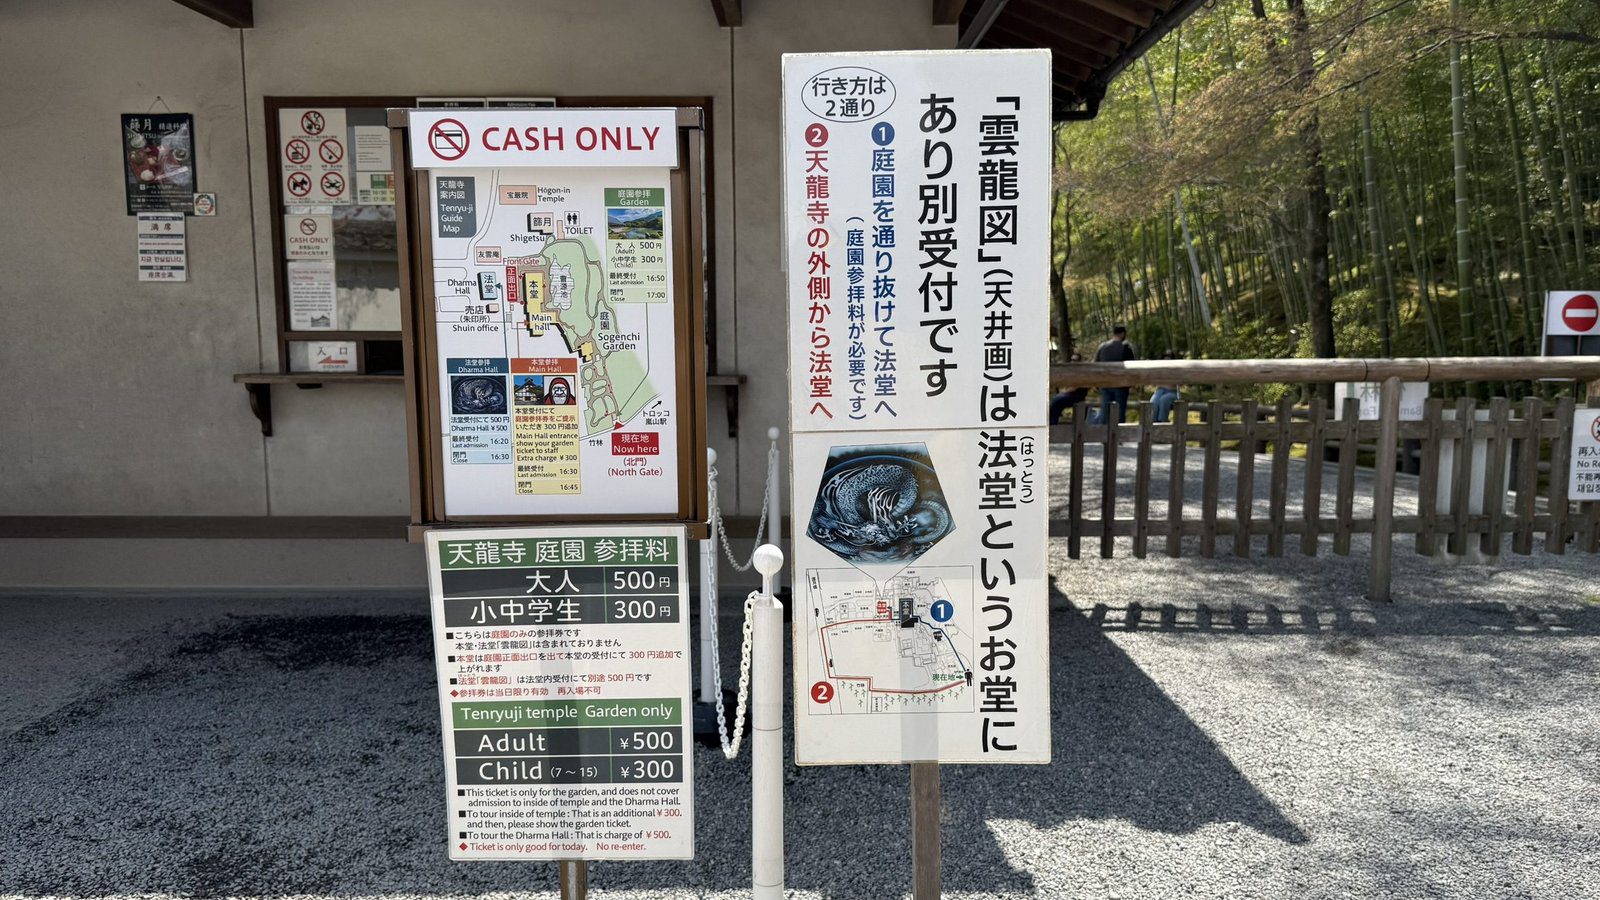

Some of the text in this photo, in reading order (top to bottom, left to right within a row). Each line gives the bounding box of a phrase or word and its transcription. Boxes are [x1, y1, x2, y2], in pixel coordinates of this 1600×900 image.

[812, 76, 886, 97] 行き方は
[825, 98, 876, 117] 2通り
[482, 126, 660, 151] CASH ONLY
[440, 180, 464, 189] 天龍寺
[440, 191, 466, 200] 案内図
[618, 190, 652, 198] 庭園参拝
[440, 204, 474, 214] Tenryu-ji
[443, 225, 460, 233] Map
[564, 226, 594, 234] TOILET
[510, 234, 545, 244] Shigetsu
[918, 93, 958, 398] あり別受付です
[484, 274, 494, 294] 法堂
[507, 267, 517, 300] 正面出口
[805, 150, 834, 420] 天龍寺の外側から法堂へ
[871, 148, 897, 418] 庭園を通り抜けて法堂へ
[529, 280, 539, 299] 本堂
[465, 305, 484, 315] 売店
[600, 312, 610, 330] 庭園
[598, 333, 640, 343] Sogenchi
[603, 342, 636, 350] Garden
[621, 434, 649, 443] 現在地
[1578, 446, 1600, 456] 再入
[608, 467, 663, 476] (North Gate)
[447, 538, 670, 565] 天龍寺 庭園 参拝料
[526, 569, 580, 594] 大人
[470, 598, 582, 624] 小中学生
[455, 628, 582, 640] こちらは庭園のみの参拝券です
[458, 664, 502, 674] 上がれます
[460, 686, 601, 697] 参拝券は当日限り有効 再入場不可
[461, 704, 673, 723] Tenryuji temple Garden only
[478, 733, 546, 752] Adult
[479, 761, 542, 781] Child
[519, 789, 538, 798] only
[539, 788, 551, 796] for
[568, 788, 600, 798] garden,
[601, 787, 617, 796] and
[619, 787, 639, 796] does
[468, 799, 512, 807] admission
[550, 798, 558, 806] of
[560, 798, 589, 808] temple
[625, 798, 659, 806] Dharma
[661, 797, 681, 805] Hall.
[536, 810, 565, 819] temple
[572, 809, 591, 817] That
[593, 809, 599, 817] is
[613, 808, 655, 817] additional
[484, 820, 506, 829] then,
[508, 820, 534, 830] please
[560, 820, 573, 828] the
[575, 820, 604, 830] garden
[606, 820, 631, 828] ticket.
[604, 831, 633, 841] charge
[634, 830, 643, 838] of
[470, 842, 496, 851] Ticket
[505, 843, 524, 852] only
[525, 842, 547, 853] good
[549, 842, 561, 850] for
[562, 843, 588, 853] today.
